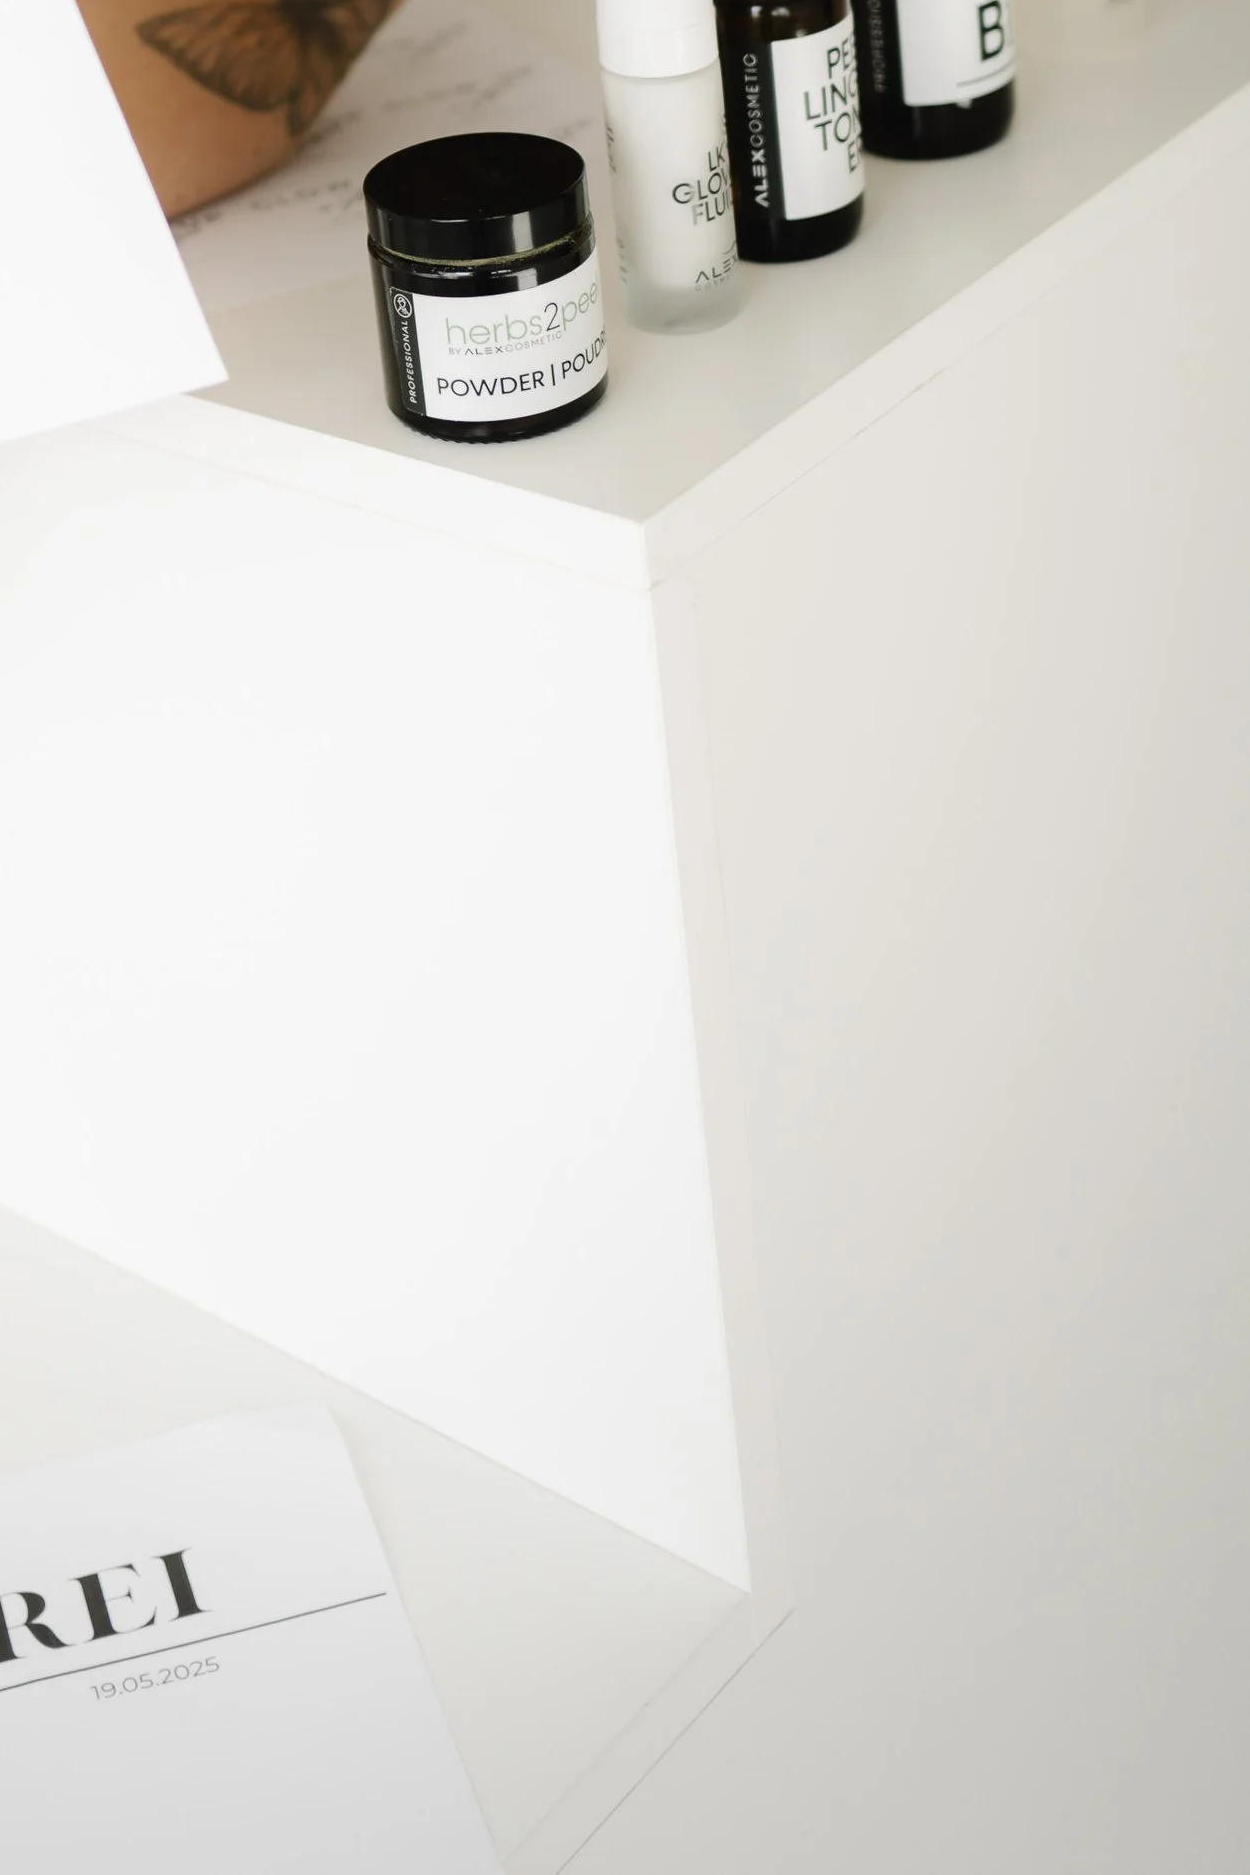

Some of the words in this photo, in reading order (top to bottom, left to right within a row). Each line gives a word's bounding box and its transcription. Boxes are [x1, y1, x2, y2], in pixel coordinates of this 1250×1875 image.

[743, 53, 771, 209] ALEXCOSMETIC
[400, 319, 418, 405] PROFESSIONAL
[437, 369, 546, 397] POWDER
[90, 1655, 221, 1702] 19.05.2025
